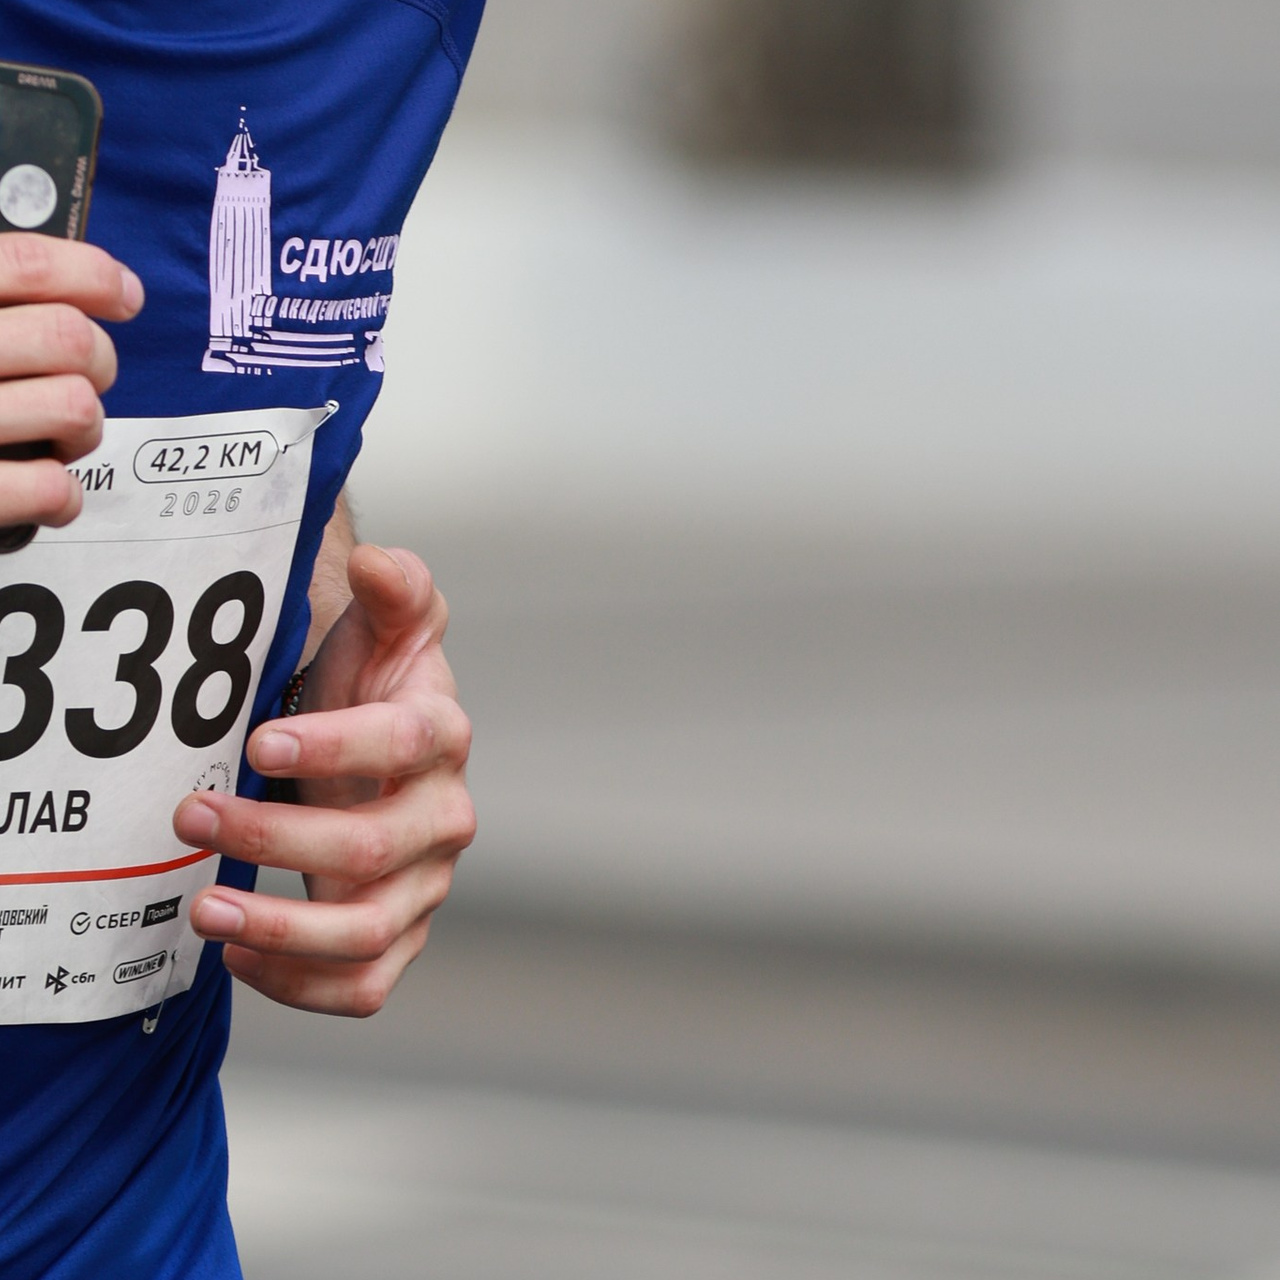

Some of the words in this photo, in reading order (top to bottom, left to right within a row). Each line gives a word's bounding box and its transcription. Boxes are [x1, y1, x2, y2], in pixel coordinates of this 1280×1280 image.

[250, 295, 278, 318] ПО
[150, 445, 210, 475] 42,2
[219, 440, 263, 469] КМ
[160, 487, 242, 518] 2026
[96, 911, 141, 930] СБЕР
[118, 957, 159, 980] WINLINE
